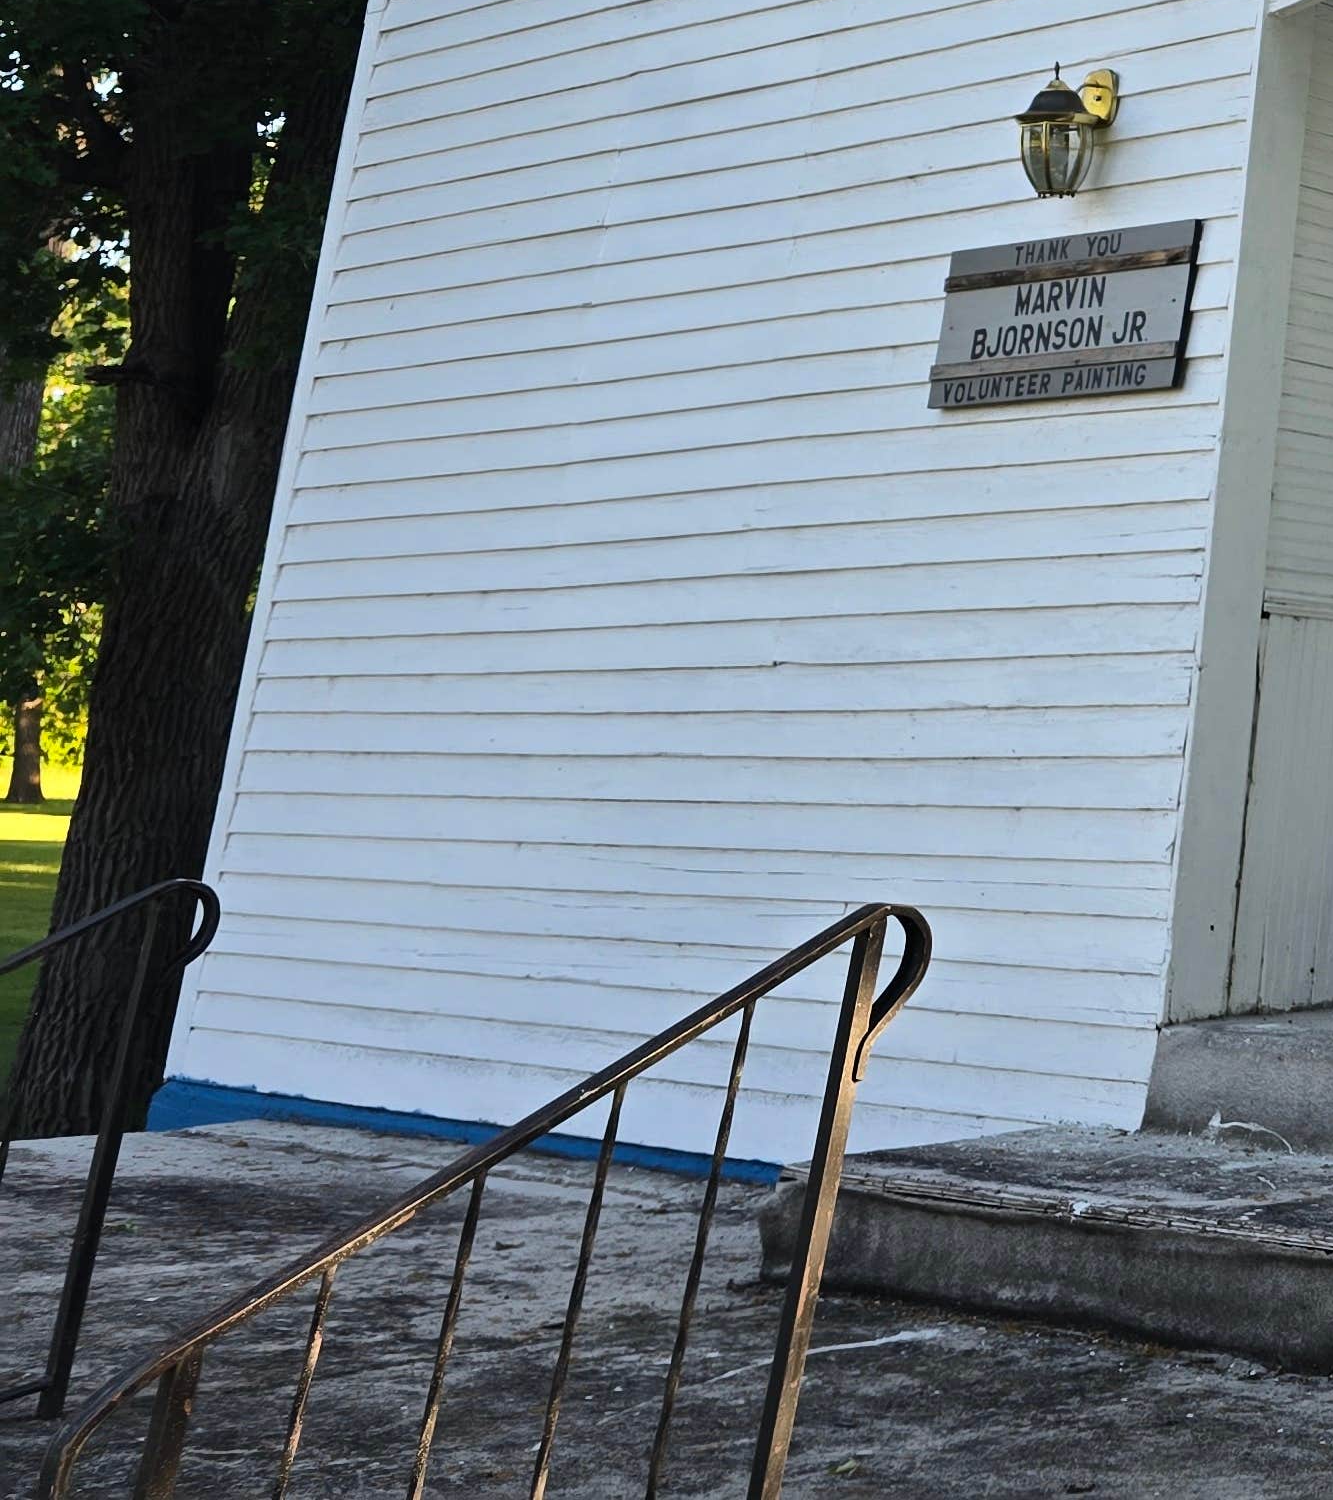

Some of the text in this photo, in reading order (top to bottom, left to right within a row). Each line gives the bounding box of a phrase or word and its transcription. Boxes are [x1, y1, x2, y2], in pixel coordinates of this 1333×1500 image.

[1016, 233, 1122, 265] THANK YOU
[1015, 277, 1106, 316] MARVIN
[971, 315, 1103, 359] BJORNSON
[943, 364, 1146, 404] VOLUNTEER PAINTING
